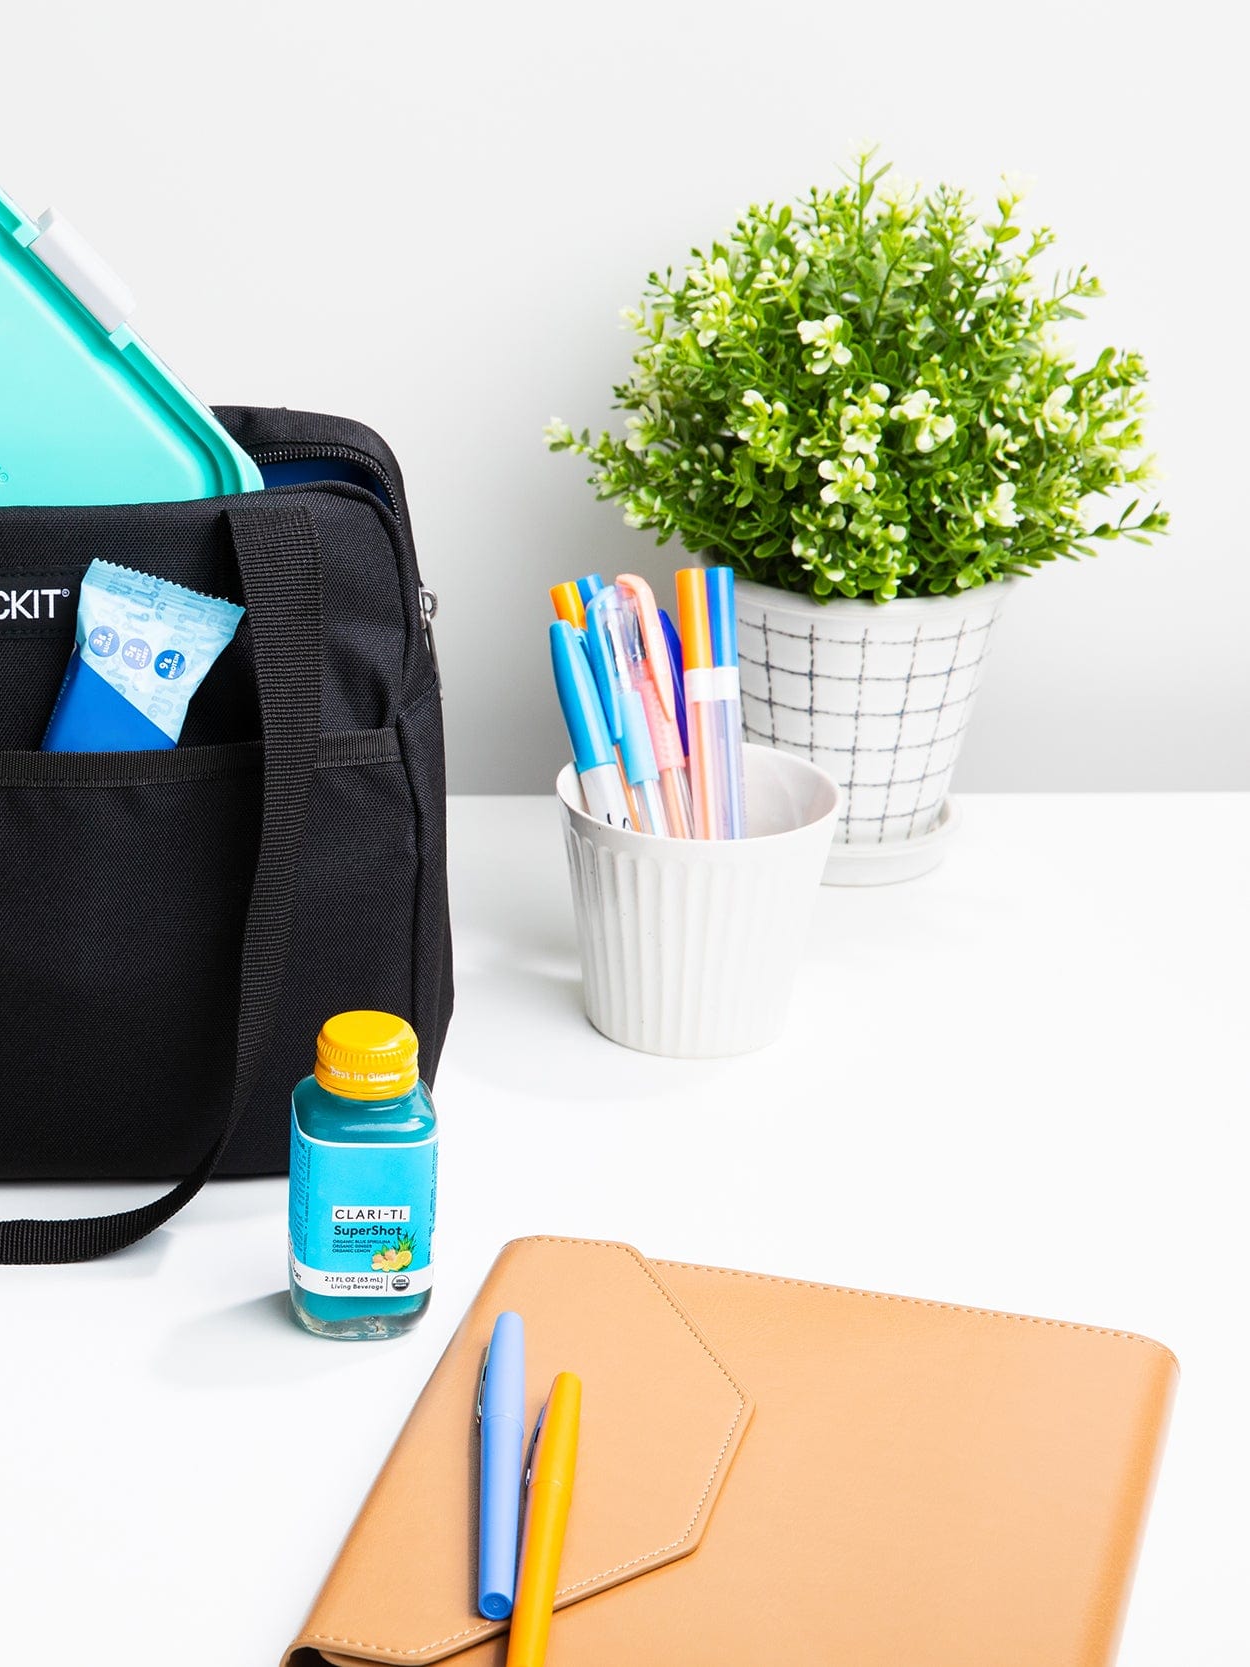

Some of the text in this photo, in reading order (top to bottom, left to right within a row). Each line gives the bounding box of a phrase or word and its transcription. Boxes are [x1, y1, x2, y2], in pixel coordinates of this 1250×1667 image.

[102, 632, 115, 653] SUGAR
[167, 653, 181, 679] PROTEIN
[334, 1225, 402, 1238] SuperShot
[324, 1275, 335, 1283] 2.1
[357, 1276, 369, 1284] (63
[369, 1276, 384, 1284] mL)
[331, 1283, 351, 1291] Living
